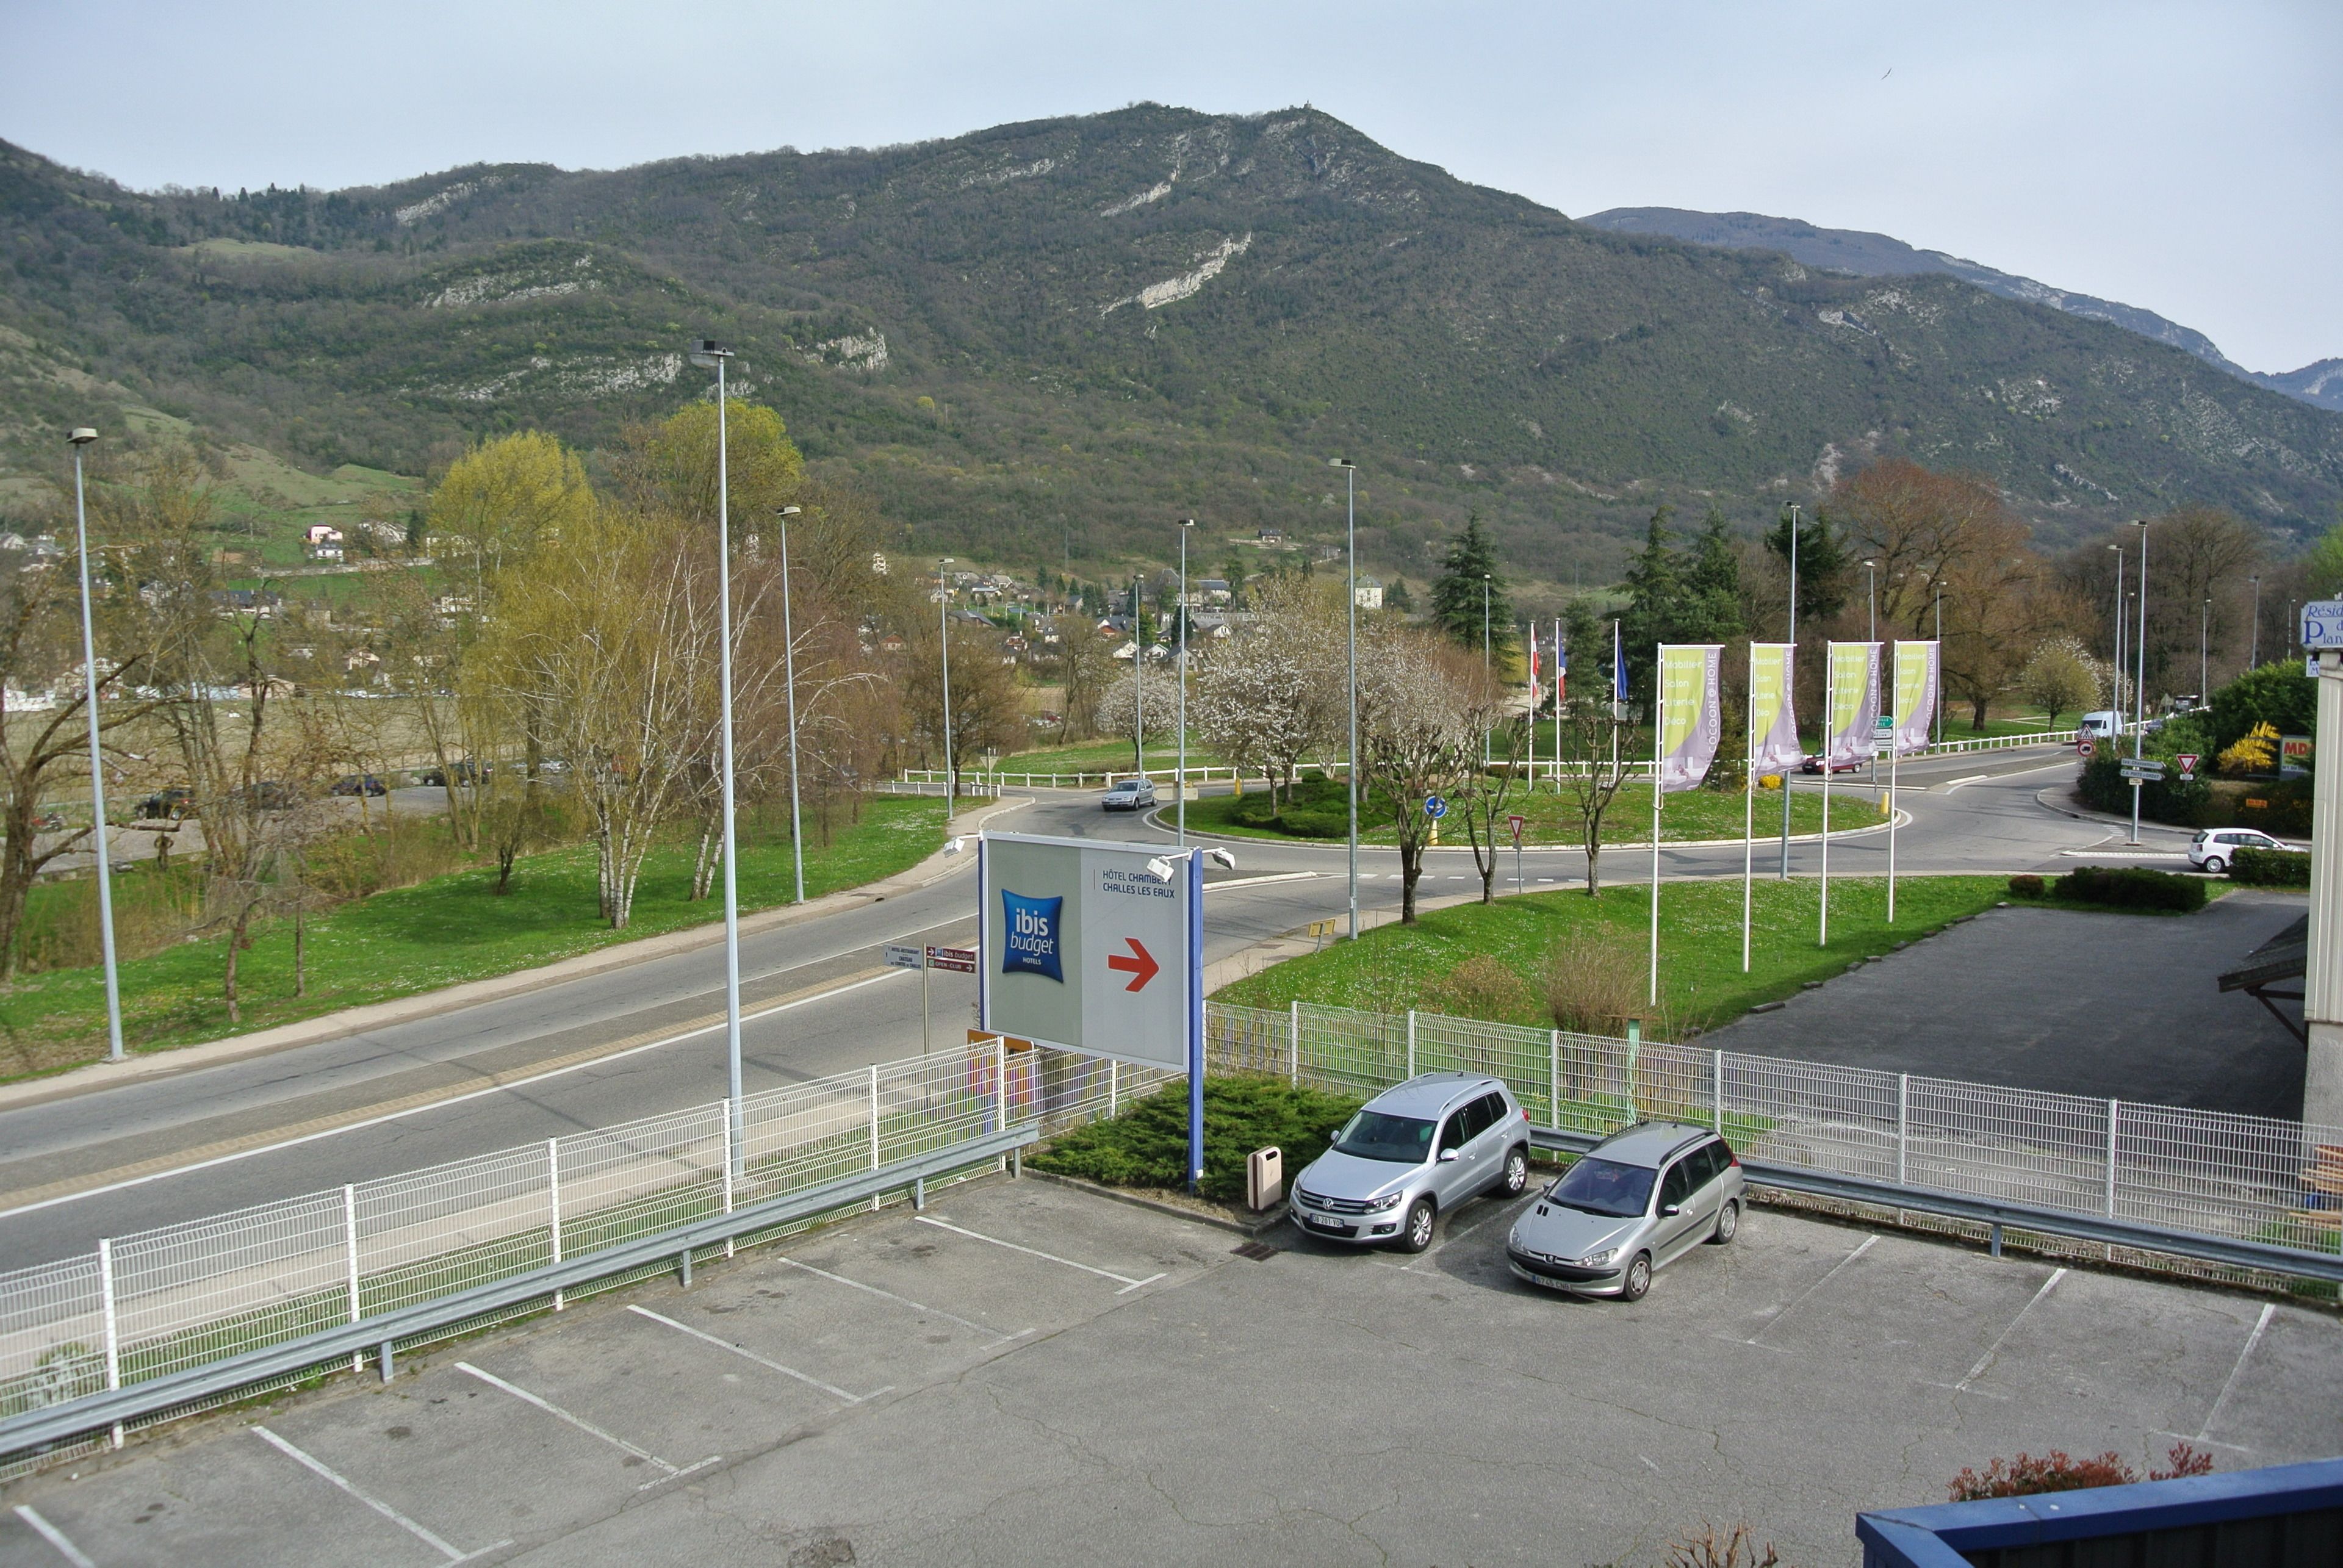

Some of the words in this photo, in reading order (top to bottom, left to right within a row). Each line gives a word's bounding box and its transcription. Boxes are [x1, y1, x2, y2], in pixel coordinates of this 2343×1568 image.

[1708, 653, 1716, 685] HOME
[1665, 679, 1689, 688] Salon
[1665, 698, 1694, 707] Literie
[1665, 717, 1686, 725] Déco
[1708, 701, 1718, 752] COCOON
[2284, 742, 2315, 755] MD
[1103, 869, 1126, 881] HÔTEL
[1103, 883, 1136, 894] CHALLES
[1137, 886, 1151, 896] LES
[1153, 888, 1175, 898] EAUX
[1016, 908, 1048, 936] ibis
[1010, 931, 1054, 956] budget
[954, 951, 973, 960] budget
[1023, 957, 1042, 965] HOTELS
